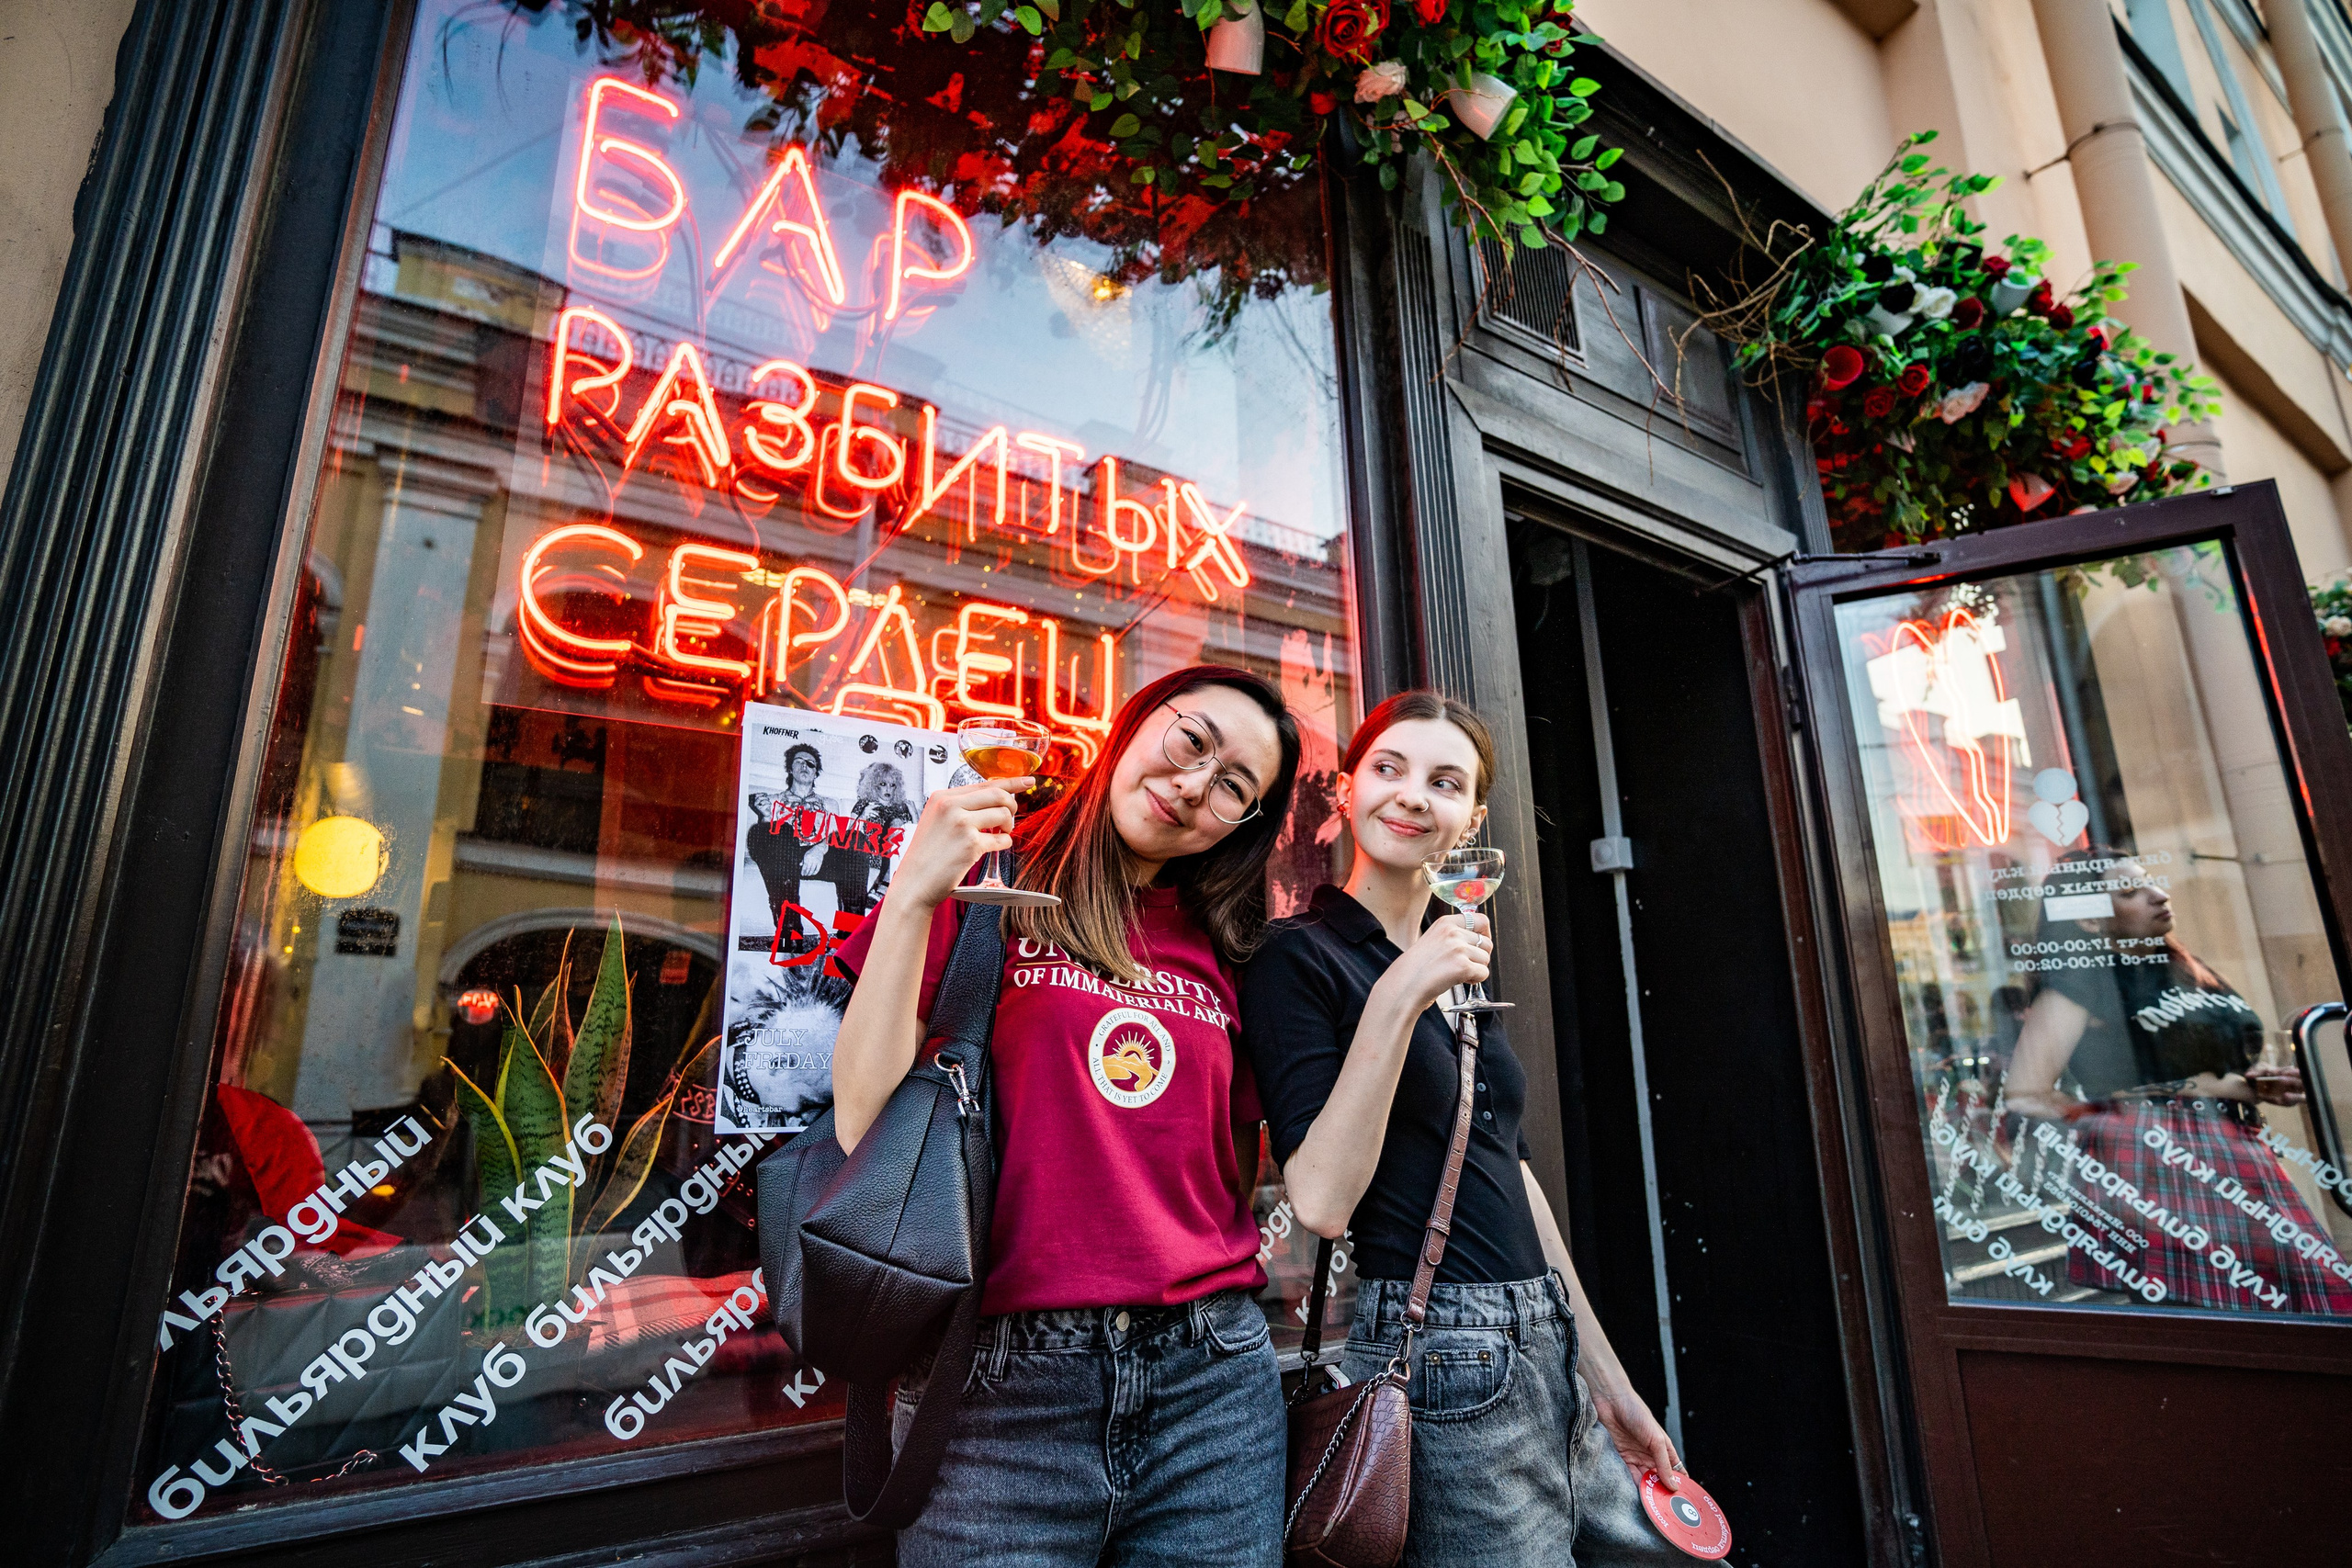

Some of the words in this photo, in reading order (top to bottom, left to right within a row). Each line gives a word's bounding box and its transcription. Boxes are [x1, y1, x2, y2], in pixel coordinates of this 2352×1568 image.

[575, 75, 976, 322] БАР
[546, 305, 1251, 590] РАЗБИТЫХ
[517, 524, 1117, 735] СЕРДЕЦ
[763, 726, 799, 739] KHOFFNER
[769, 800, 906, 858] PUNKS
[1013, 967, 1046, 988] OF
[1048, 967, 1191, 1017] IMMATERIAL
[1018, 937, 1222, 1012] UNRSITY
[744, 1028, 808, 1046] JULY
[1098, 1011, 1132, 1037] GRATEFUL
[1133, 1011, 1149, 1022] FOR
[1149, 1021, 1160, 1034] ALL
[1159, 1033, 1171, 1053] AND
[741, 1052, 833, 1070] FRIDAY
[1092, 1056, 1102, 1076] ALL
[1097, 1074, 1115, 1096] THAT
[1114, 1092, 1121, 1101] IS
[1122, 1095, 1138, 1103] YET
[1138, 1092, 1150, 1102] TO
[1150, 1072, 1169, 1096] COME
[148, 1213, 505, 1519] бильярдный
[501, 1111, 613, 1225] клуб
[399, 1341, 527, 1472] клуб
[1688, 1508, 1697, 1517] 8
[1702, 1495, 1718, 1513] бар
